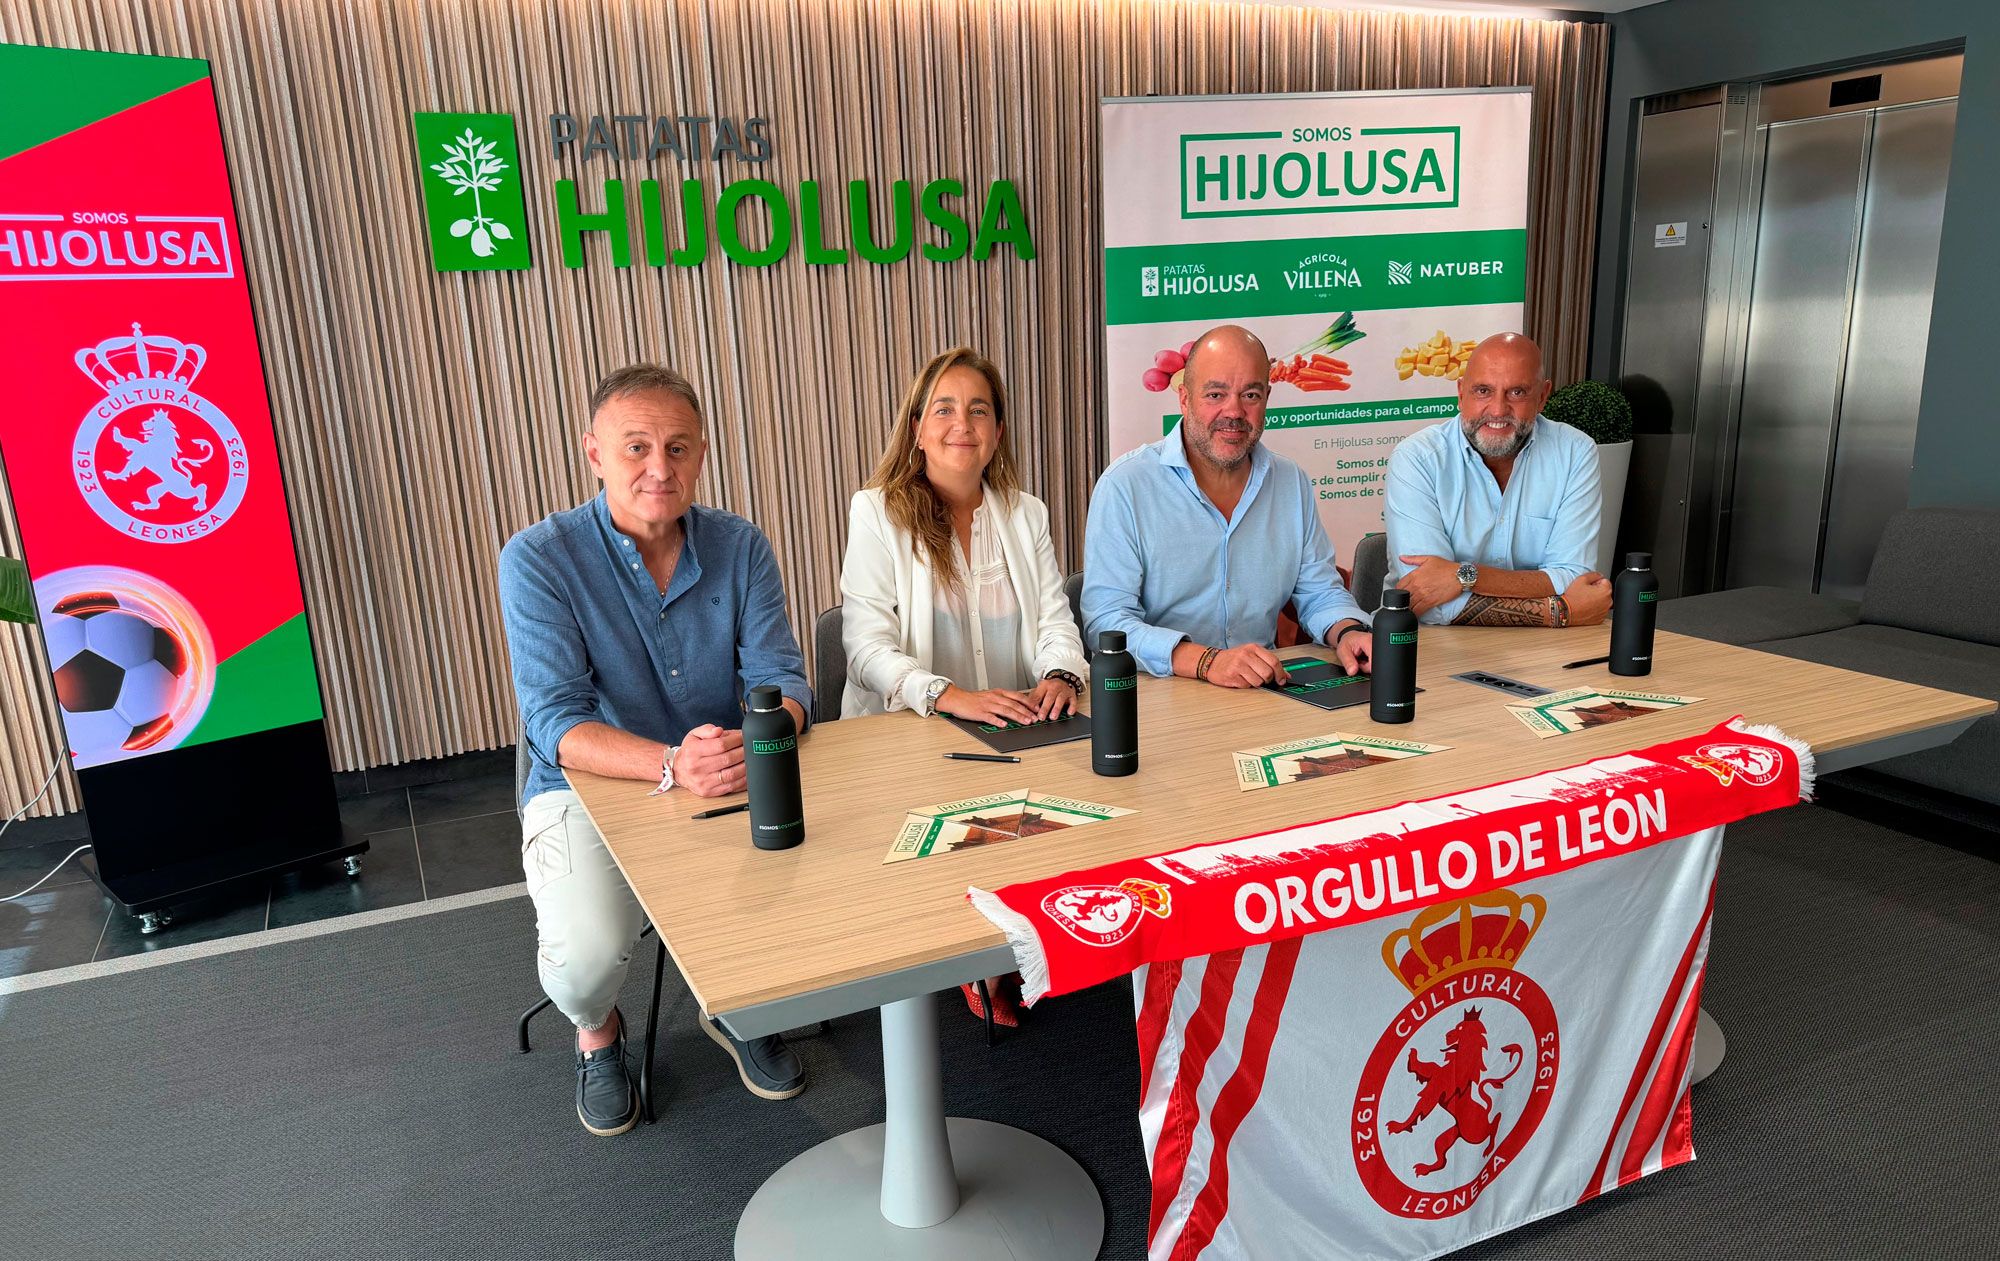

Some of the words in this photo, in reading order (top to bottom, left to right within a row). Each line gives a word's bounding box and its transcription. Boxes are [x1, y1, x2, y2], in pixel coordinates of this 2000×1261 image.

[549, 113, 770, 162] PATATAS
[1292, 127, 1352, 143] SOMOS
[1196, 147, 1447, 202] HIJOLUSA
[72, 212, 129, 224] SOMOS
[555, 179, 1036, 268] HIJOLUSA
[1163, 264, 1205, 275] PATATAS
[1299, 252, 1347, 269] AGRÍCOLA
[1420, 260, 1504, 278] NATUBER
[1163, 273, 1259, 296] HIJOLUSA
[1283, 267, 1362, 290] VILLENA
[97, 388, 202, 419] CULTURAL
[1281, 414, 1287, 425] y
[1289, 407, 1372, 424] oportunidades
[1375, 406, 1400, 418] para
[1402, 404, 1414, 414] el
[1415, 404, 1455, 415] campo
[1314, 439, 1328, 449] En
[1331, 436, 1373, 450] Hijolusa
[227, 437, 246, 479] 1923
[1336, 459, 1374, 469] Somos
[1377, 457, 1388, 466] de
[77, 449, 98, 494] 1923
[1320, 476, 1334, 485] de
[1337, 472, 1379, 484] cumplir
[1320, 490, 1357, 500] Somos
[1360, 487, 1374, 497] de
[128, 513, 222, 540] LEONESA
[1234, 839, 1478, 935] ORGULLO
[1487, 820, 1545, 880] DE
[1556, 788, 1668, 862] LEÓN
[1100, 929, 1124, 942] 1923
[1395, 973, 1524, 1038] CULTURAL
[1536, 1031, 1555, 1092] 1923
[1357, 1093, 1376, 1162] 1923
[1401, 1155, 1506, 1215] LEONESA
